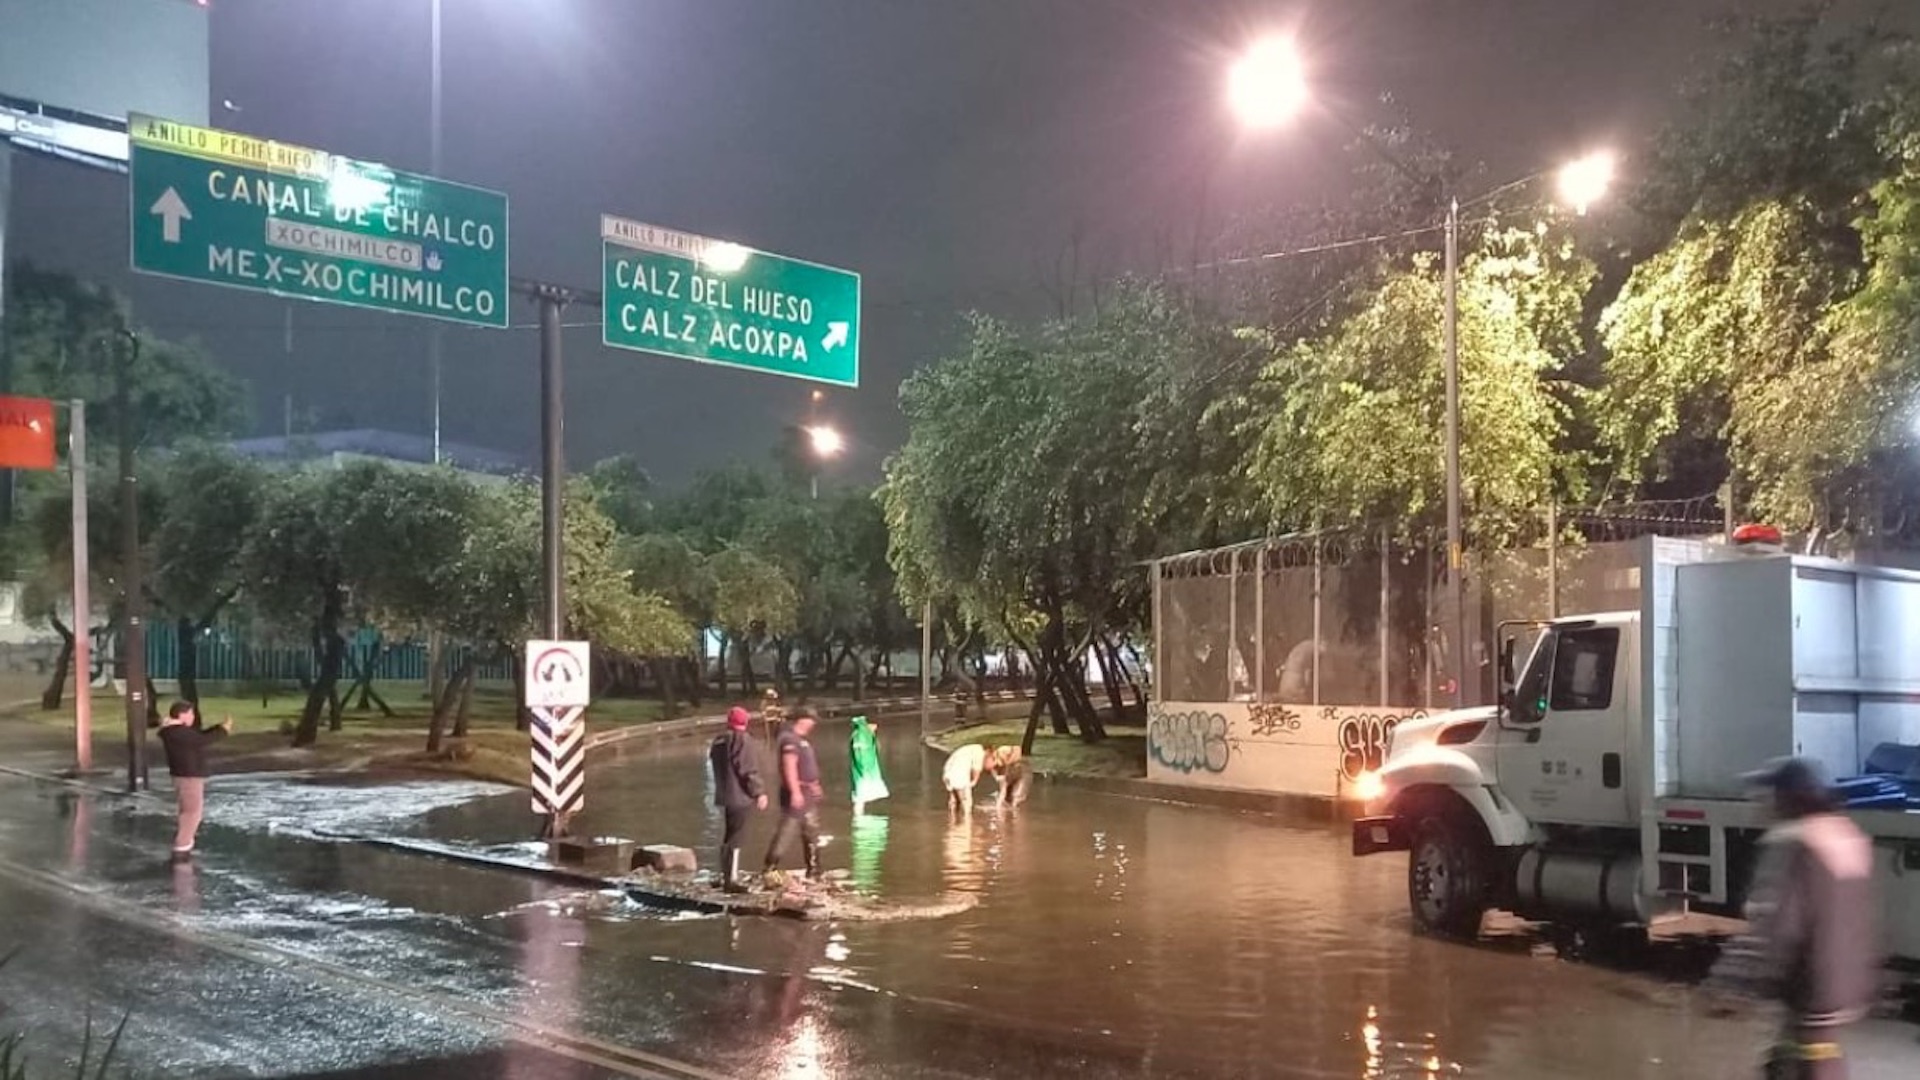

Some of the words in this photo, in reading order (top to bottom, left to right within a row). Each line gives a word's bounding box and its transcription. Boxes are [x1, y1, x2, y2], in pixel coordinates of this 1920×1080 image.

[147, 121, 207, 149] ANILLO
[208, 170, 321, 217] CANAL
[383, 204, 495, 250] CHALCO
[613, 221, 655, 243] ANILLO
[277, 225, 413, 264] XOCHIMILCO
[208, 244, 495, 317] MEX-XOCHIMILCO
[615, 260, 681, 299] CALZ
[691, 276, 733, 310] DEL
[743, 286, 813, 325] HUESO
[621, 304, 697, 343] CALZ
[709, 321, 808, 363] ACOXPA
